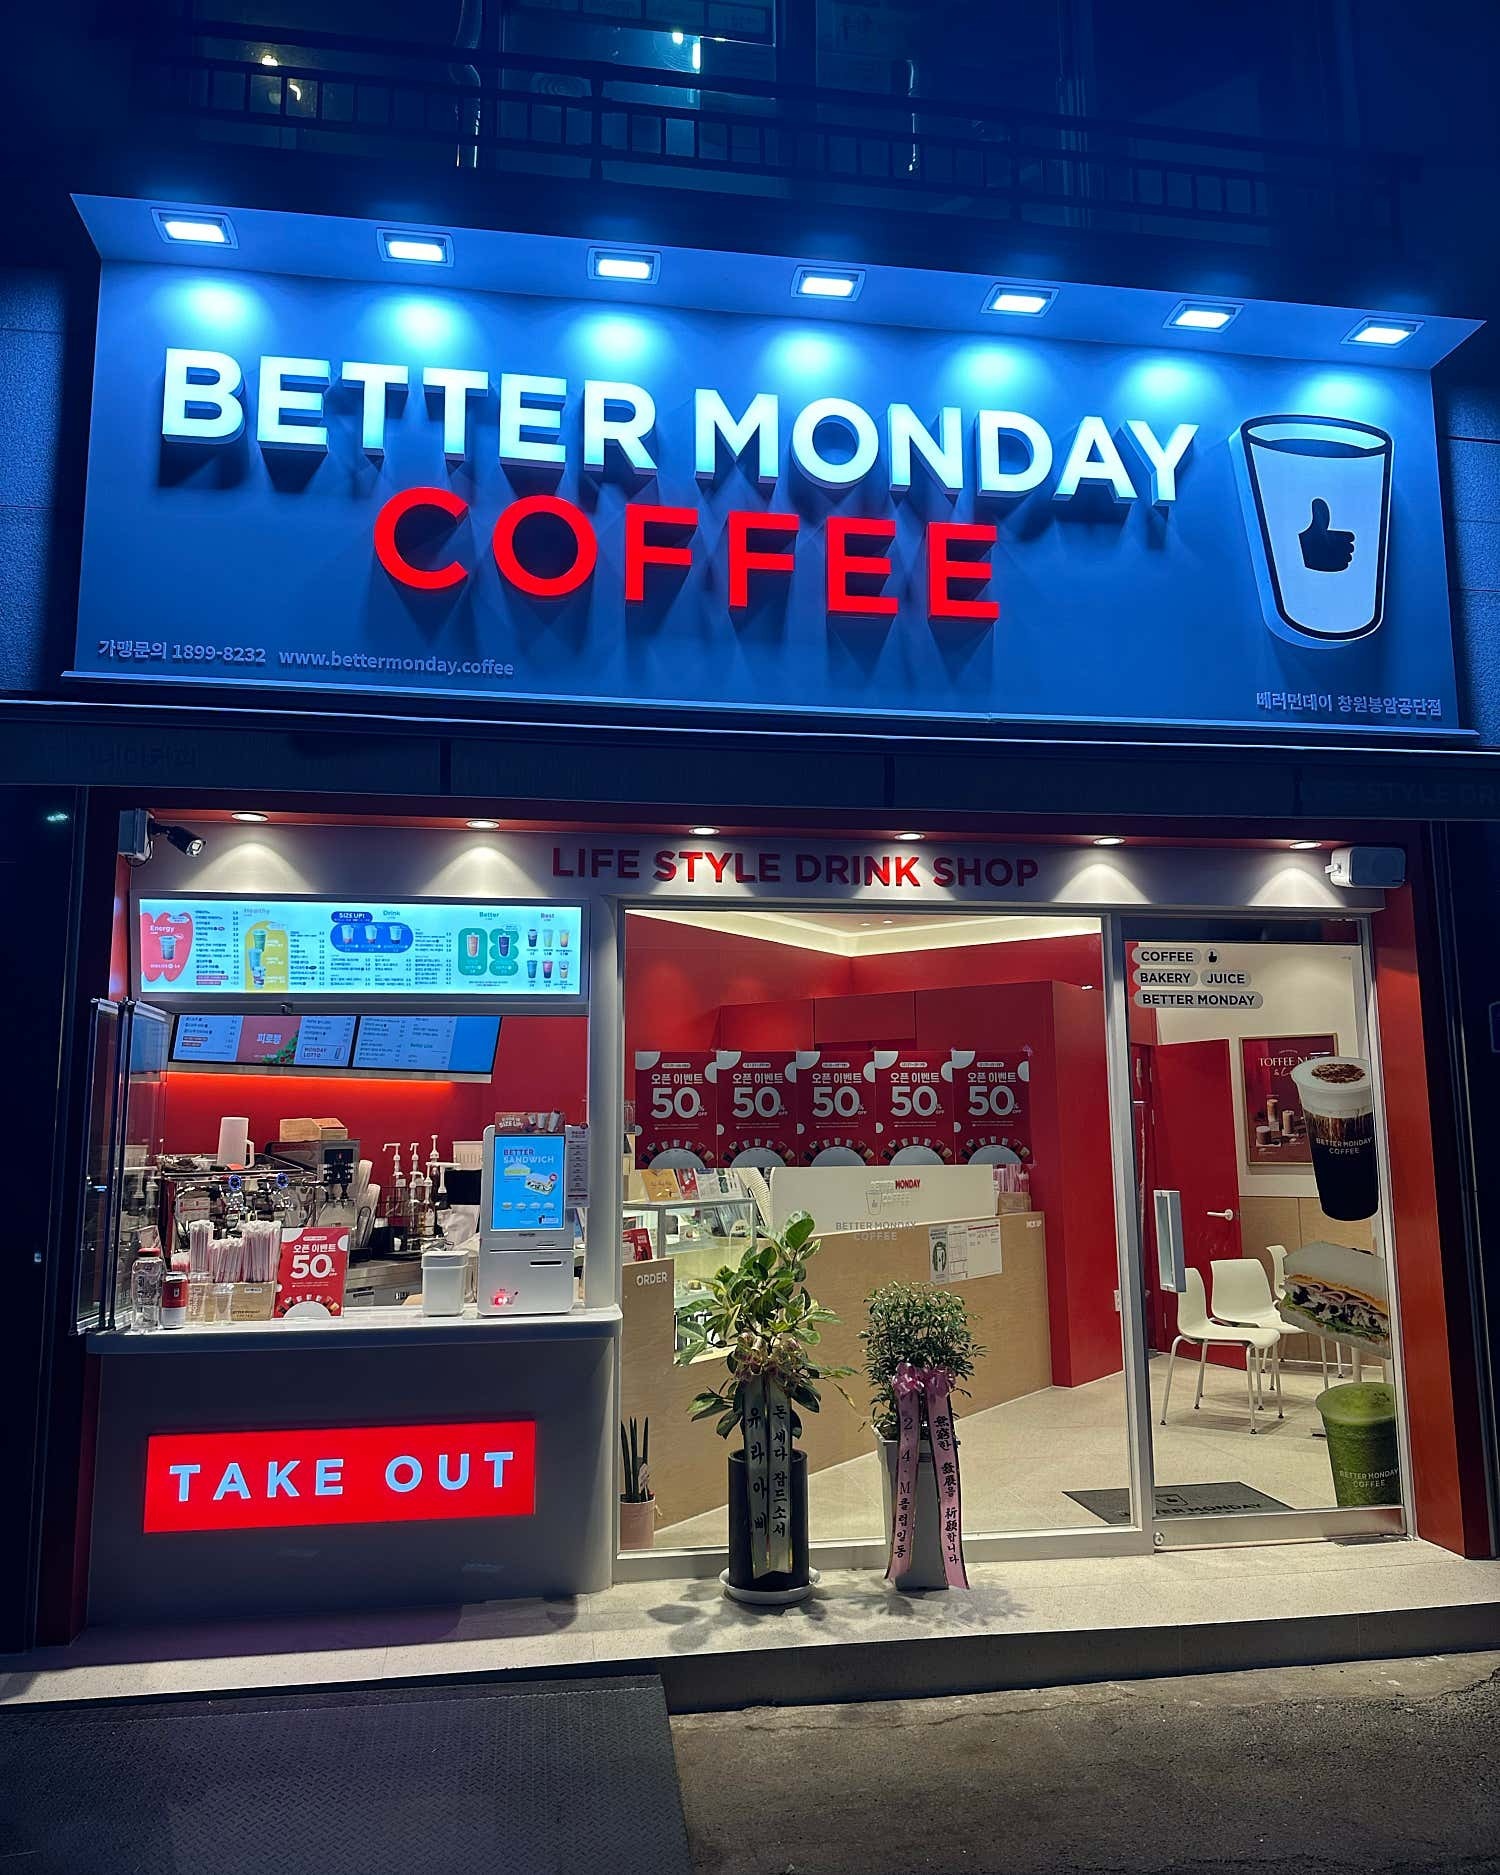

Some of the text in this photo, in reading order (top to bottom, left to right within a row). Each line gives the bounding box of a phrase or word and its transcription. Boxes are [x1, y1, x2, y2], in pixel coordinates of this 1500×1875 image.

[161, 347, 1200, 505] BETTER MONDAY
[373, 486, 999, 620] COFFEE
[98, 640, 267, 664] 가맹문의 1899-8232
[279, 649, 514, 676] www.bettermonday.coffee
[1337, 695, 1442, 717] 창원봉암공단점
[553, 847, 1040, 889] LIFE STYLE DRINK SHOP
[150, 925, 175, 934] Energy
[1141, 951, 1194, 962] COFFEE
[1140, 973, 1191, 983] BAKERY
[1207, 973, 1246, 984] JUICE
[1142, 994, 1256, 1006] BETTER MONDAY
[1258, 1056, 1296, 1067] TOFFEE
[651, 1073, 704, 1085] 오픈 이벤트
[732, 1072, 784, 1085] 오픈 이벤트
[811, 1072, 862, 1084] 오픈 이벤트
[890, 1072, 940, 1084] 오픈 이벤트
[967, 1072, 1017, 1084] 오픈 이벤트
[1315, 1136, 1373, 1148] BETTER MONDAY
[503, 1148, 535, 1156] BETTER
[1329, 1147, 1360, 1155] COFFEE
[503, 1155, 555, 1164] SANDWICH
[895, 1178, 921, 1190] MONDAY
[835, 1220, 873, 1231] BETTER
[292, 1243, 337, 1253] 오픈 이벤트
[636, 1271, 668, 1287] ORDER
[168, 1451, 514, 1502] TAKE OUT
[771, 1405, 788, 1538] 돈 세다 잠드소서
[1339, 1467, 1399, 1480] BETTER MONDAY
[1353, 1479, 1386, 1488] COFFEE
[1187, 1503, 1262, 1513] MONDAY
